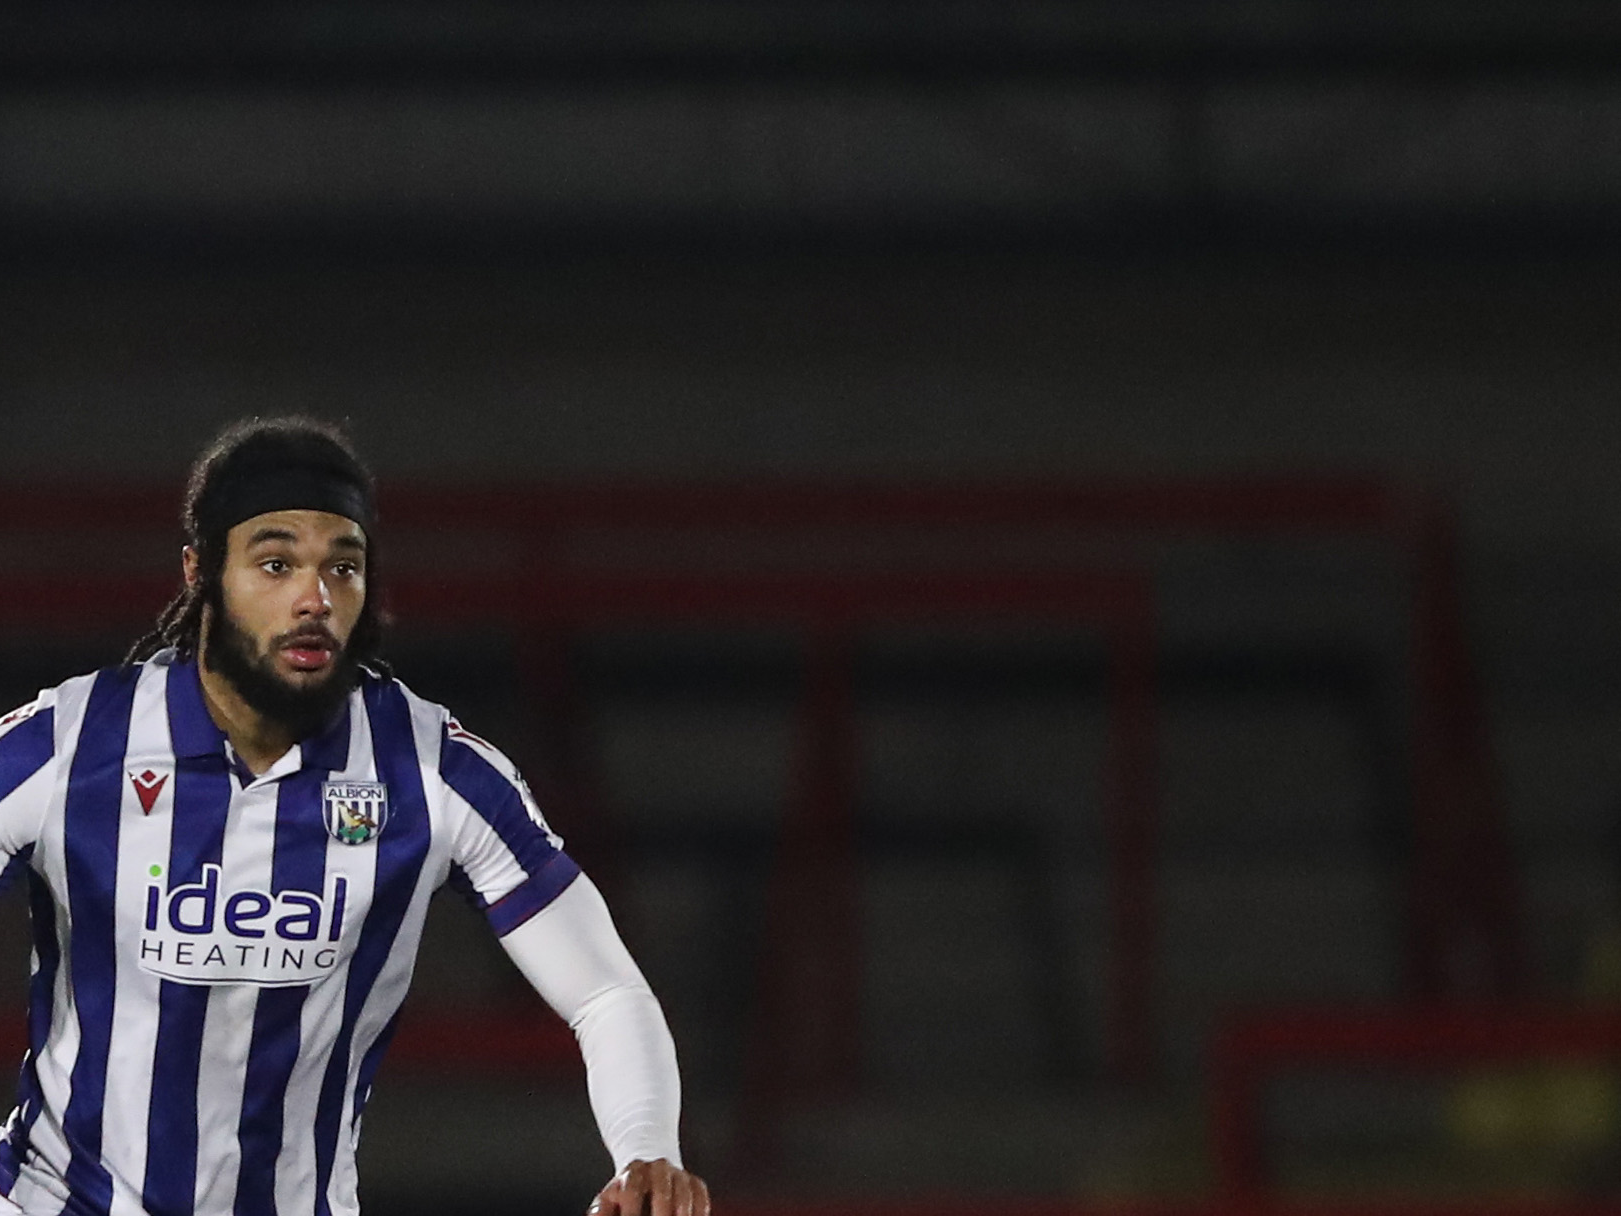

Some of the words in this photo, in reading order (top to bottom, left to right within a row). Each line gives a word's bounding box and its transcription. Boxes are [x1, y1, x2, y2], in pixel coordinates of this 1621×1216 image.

[328, 788, 382, 799] ALBION
[145, 864, 348, 942] ideal
[141, 939, 337, 970] HEATING
